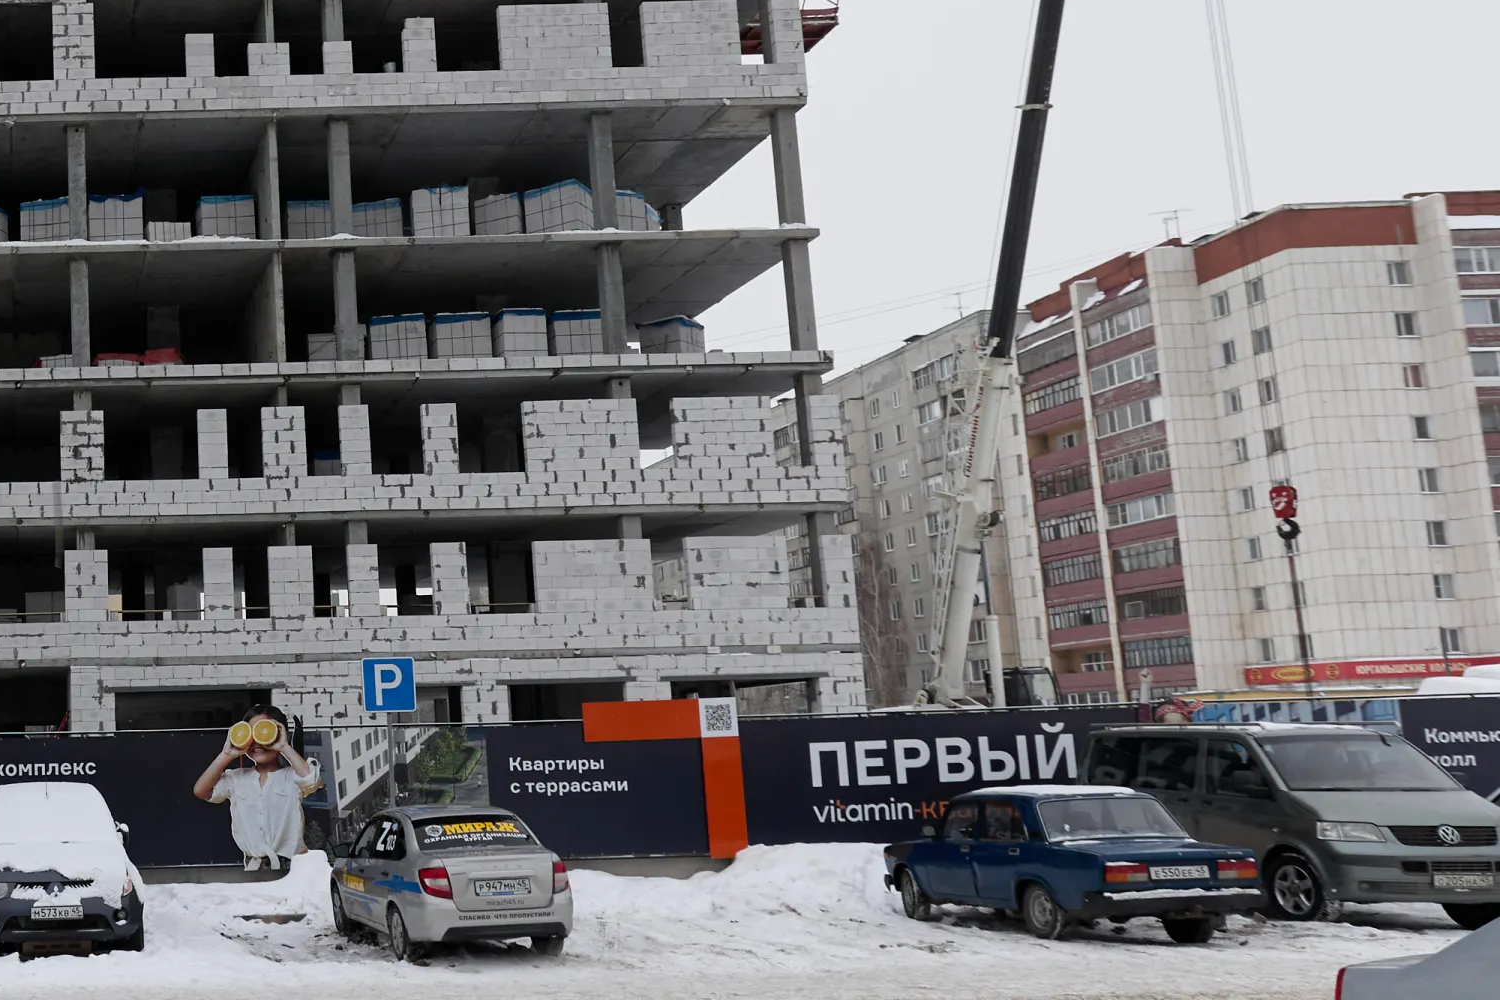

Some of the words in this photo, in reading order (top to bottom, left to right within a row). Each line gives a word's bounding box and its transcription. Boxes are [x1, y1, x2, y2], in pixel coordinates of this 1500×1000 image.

[374, 663, 402, 706] P
[809, 722, 1078, 788] ПЕРВЫЙ
[509, 757, 605, 774] Квартиры
[510, 782, 521, 793] с
[525, 780, 628, 796] террасами
[443, 822, 520, 835] МИРАЖ
